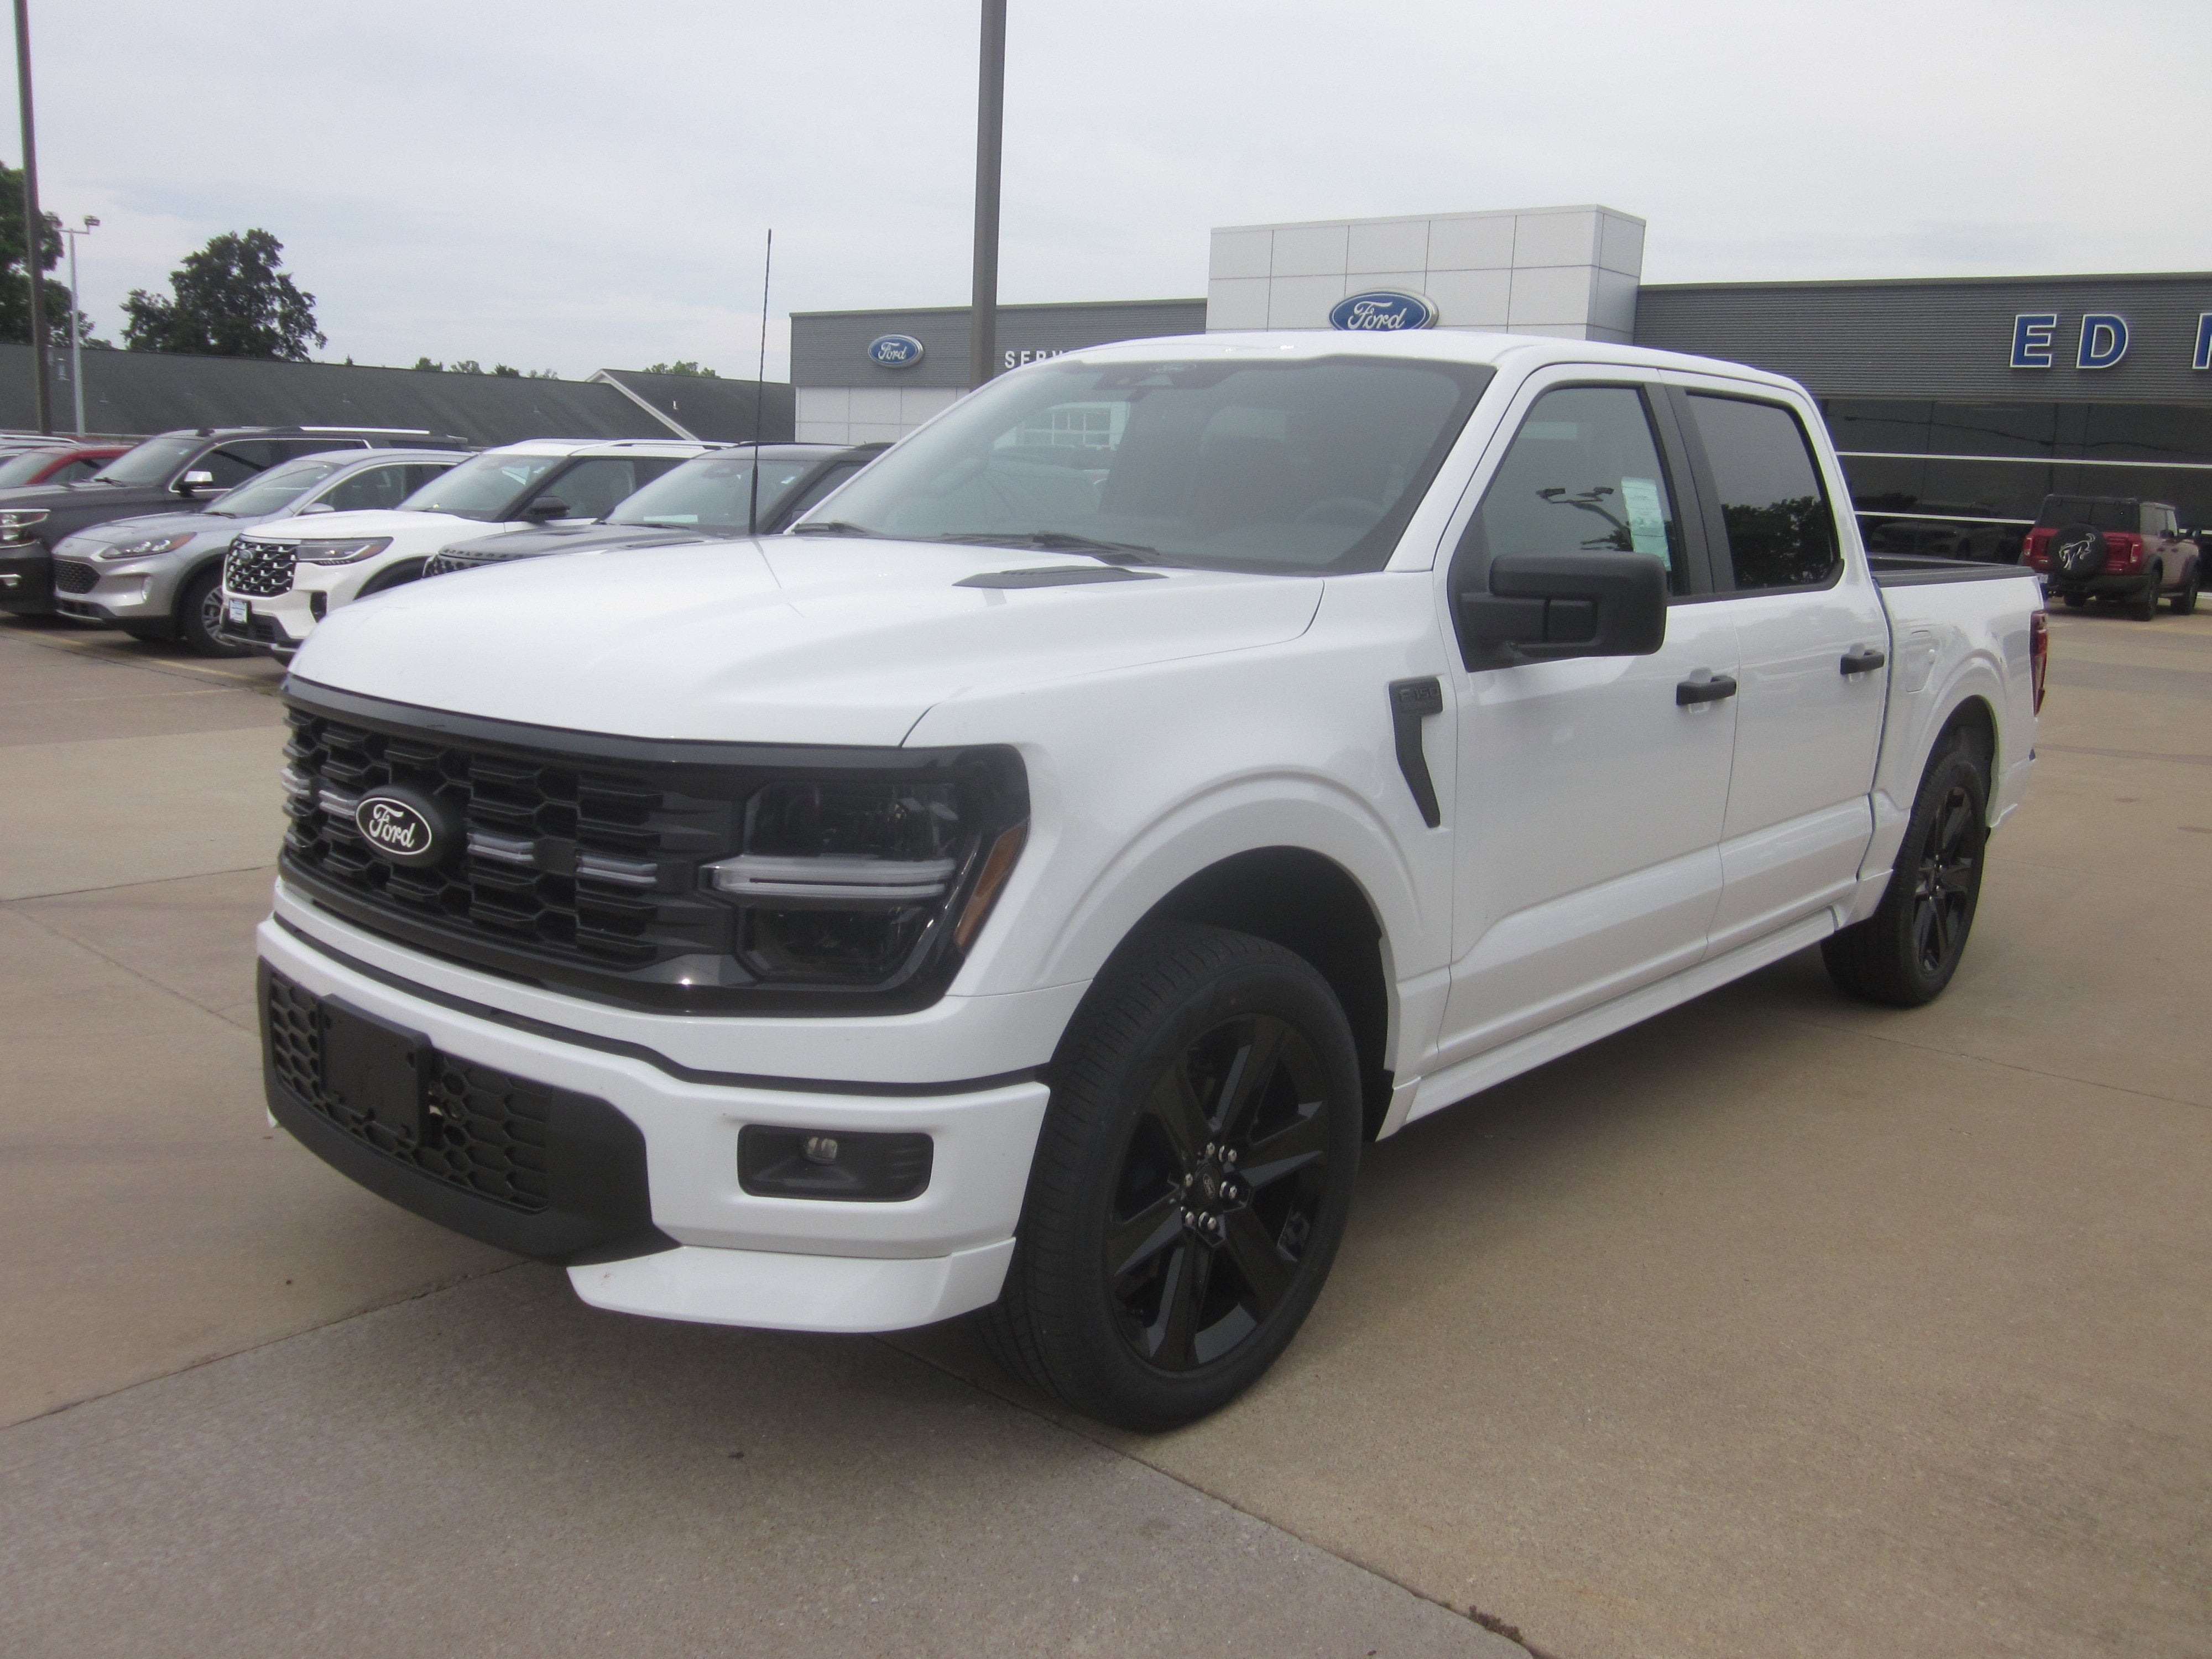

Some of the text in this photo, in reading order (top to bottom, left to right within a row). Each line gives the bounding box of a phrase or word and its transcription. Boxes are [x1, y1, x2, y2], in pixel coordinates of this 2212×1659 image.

[1347, 301, 1407, 330] Ford
[878, 342, 907, 360] Ford
[2010, 314, 2129, 369] ED
[369, 804, 416, 848] Ford
